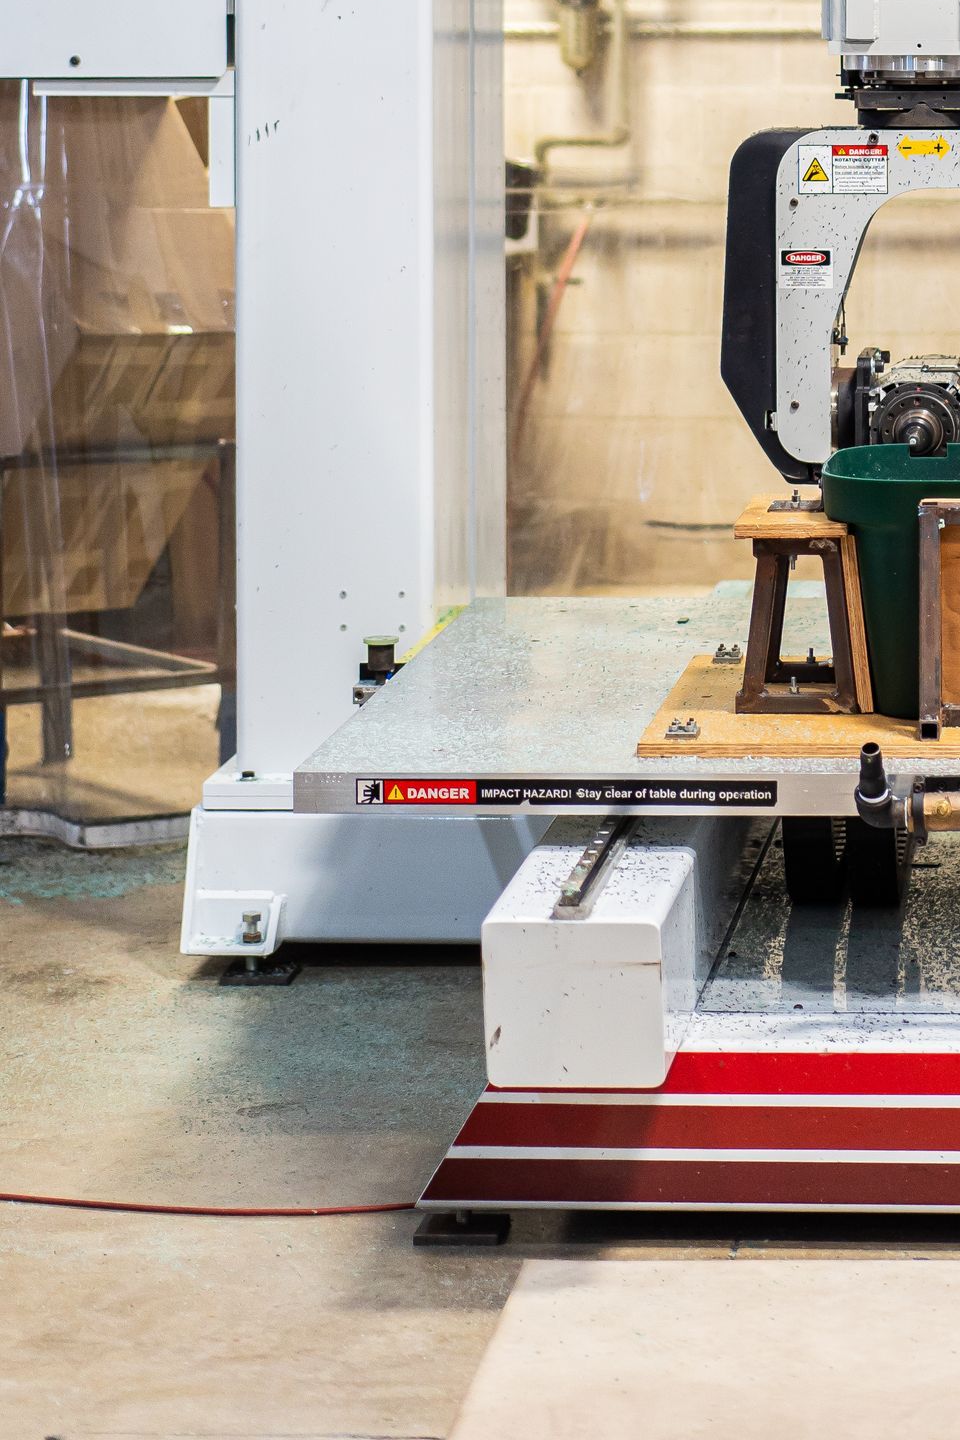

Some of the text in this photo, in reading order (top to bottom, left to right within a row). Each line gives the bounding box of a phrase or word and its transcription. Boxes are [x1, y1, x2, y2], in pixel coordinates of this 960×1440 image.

[407, 788, 772, 801] DANGER IMPACT HAZARD! Stay clear of table during operation
